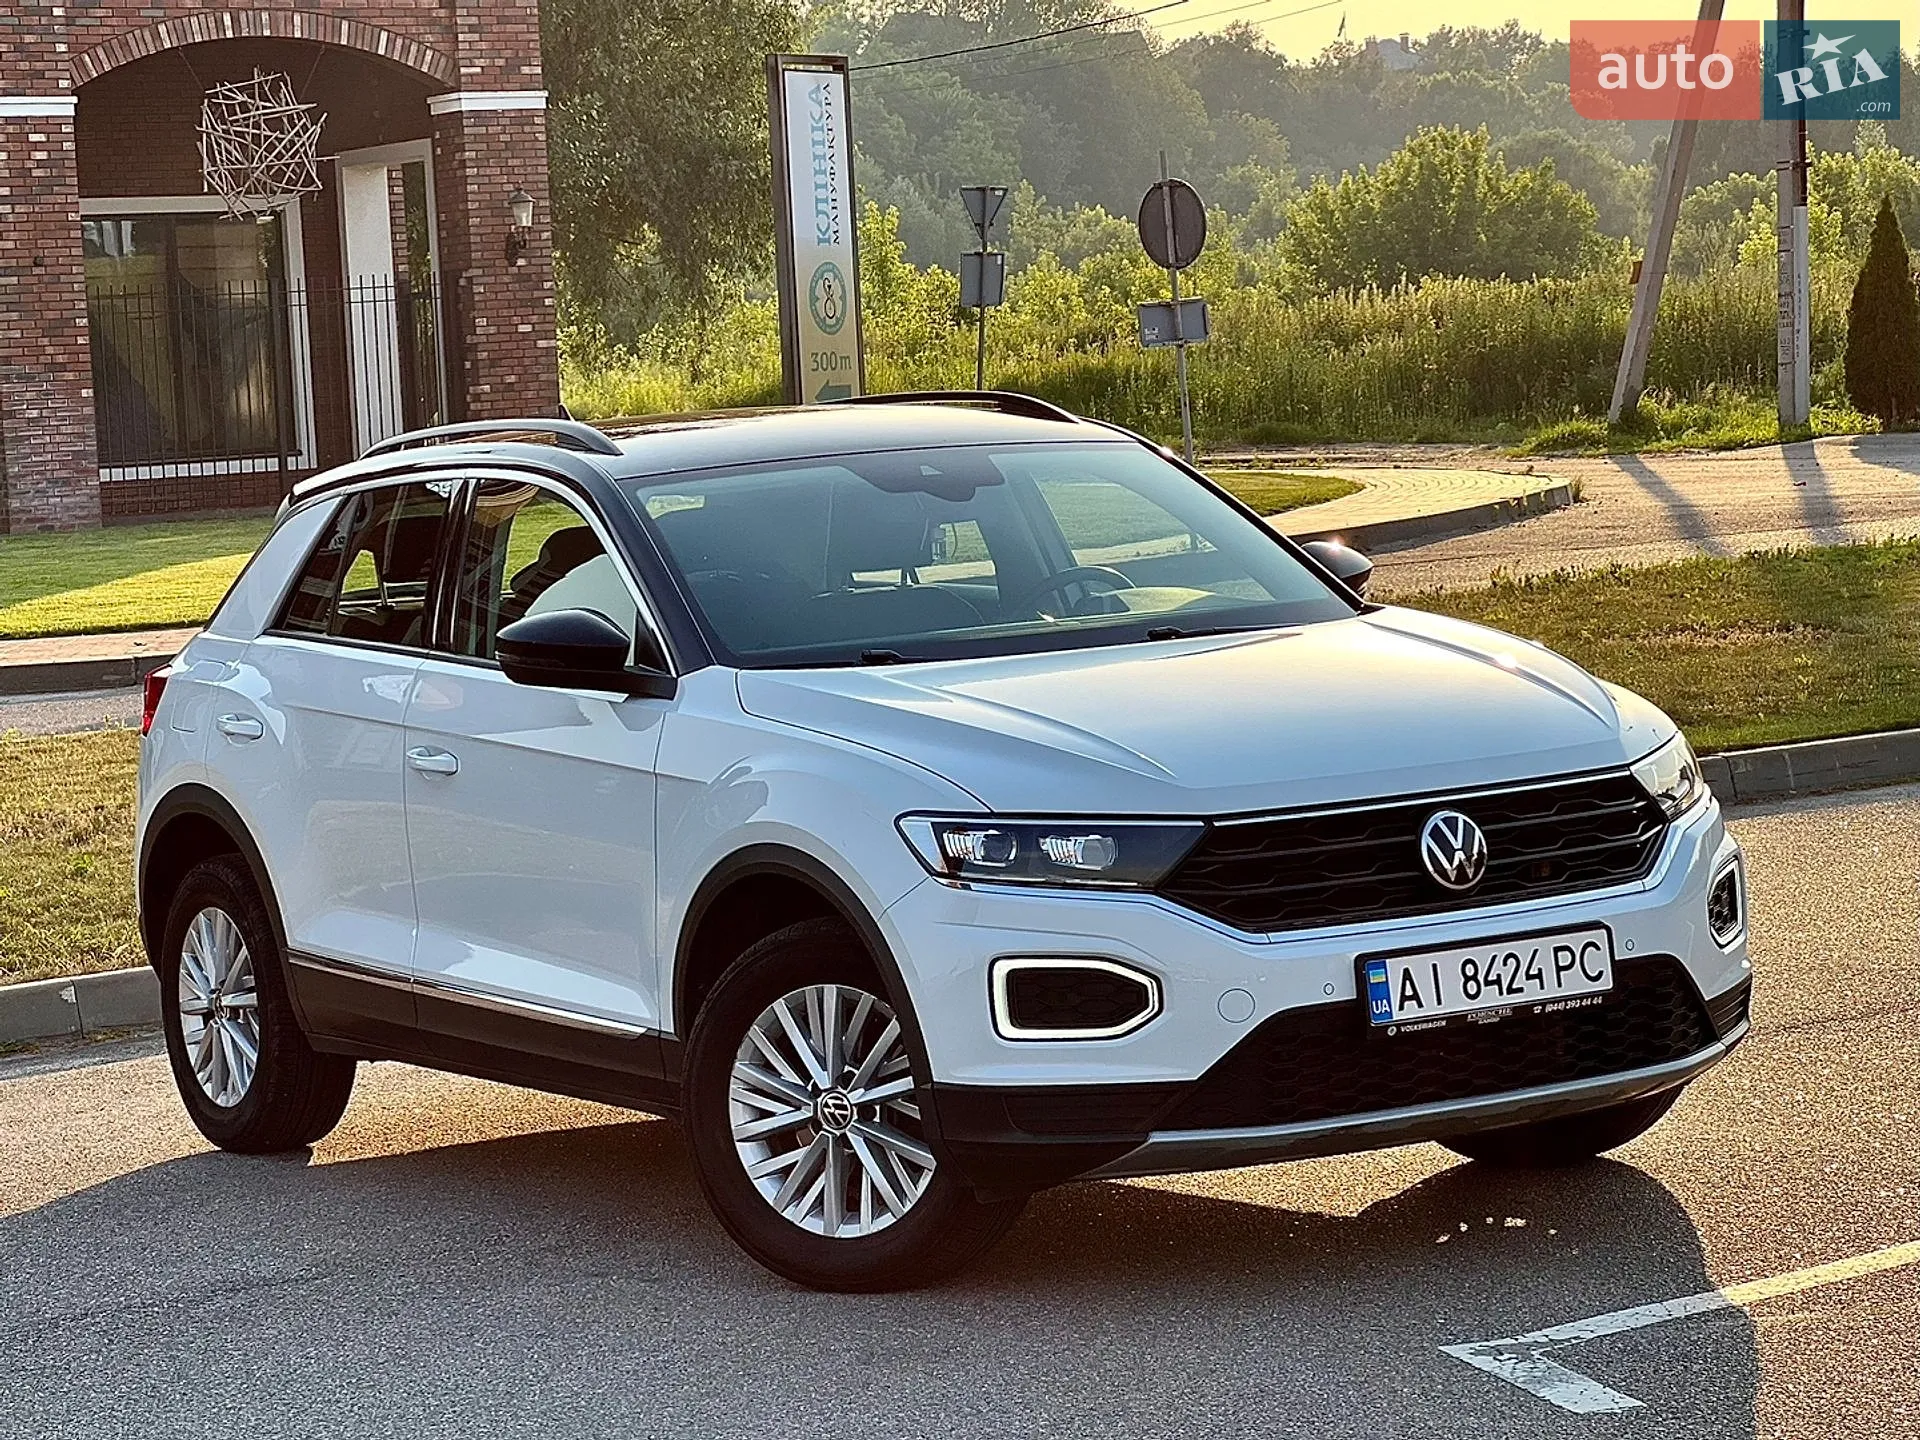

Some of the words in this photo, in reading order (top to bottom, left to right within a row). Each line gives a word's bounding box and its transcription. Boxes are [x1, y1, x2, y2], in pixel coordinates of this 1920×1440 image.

[808, 83, 831, 246] КЛІНІКА
[822, 82, 840, 245] МАНУФАКТУРА
[1372, 999, 1391, 1015] UA
[1460, 948, 1545, 1001] 8424
[1552, 941, 1604, 988] PC
